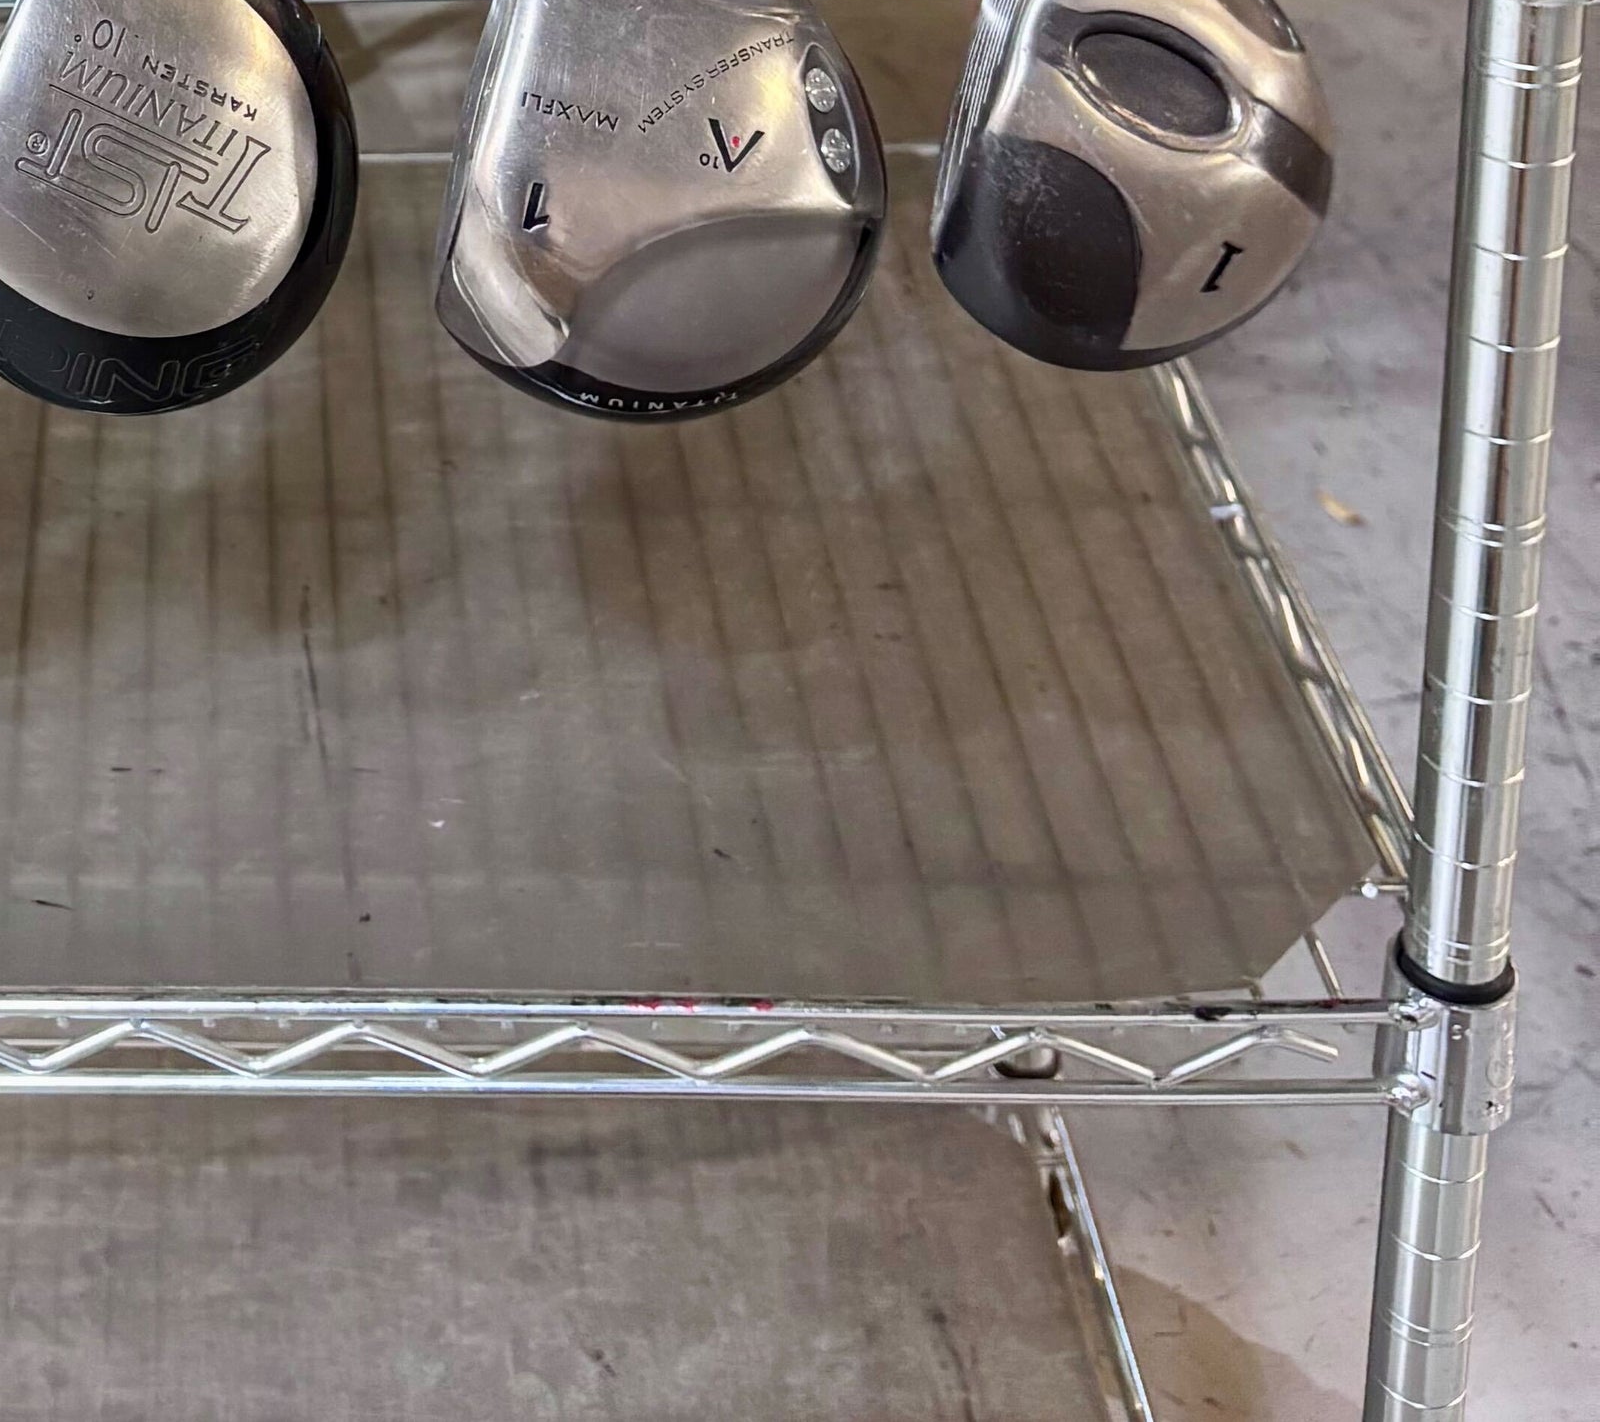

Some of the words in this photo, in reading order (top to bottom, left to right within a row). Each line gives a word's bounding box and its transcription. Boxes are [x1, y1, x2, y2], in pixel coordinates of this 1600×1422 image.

[700, 30, 796, 81] TRANSFER
[142, 57, 258, 122] KARSTEN
[519, 90, 620, 131] MAXFLI
[637, 69, 707, 134] SYSTEM
